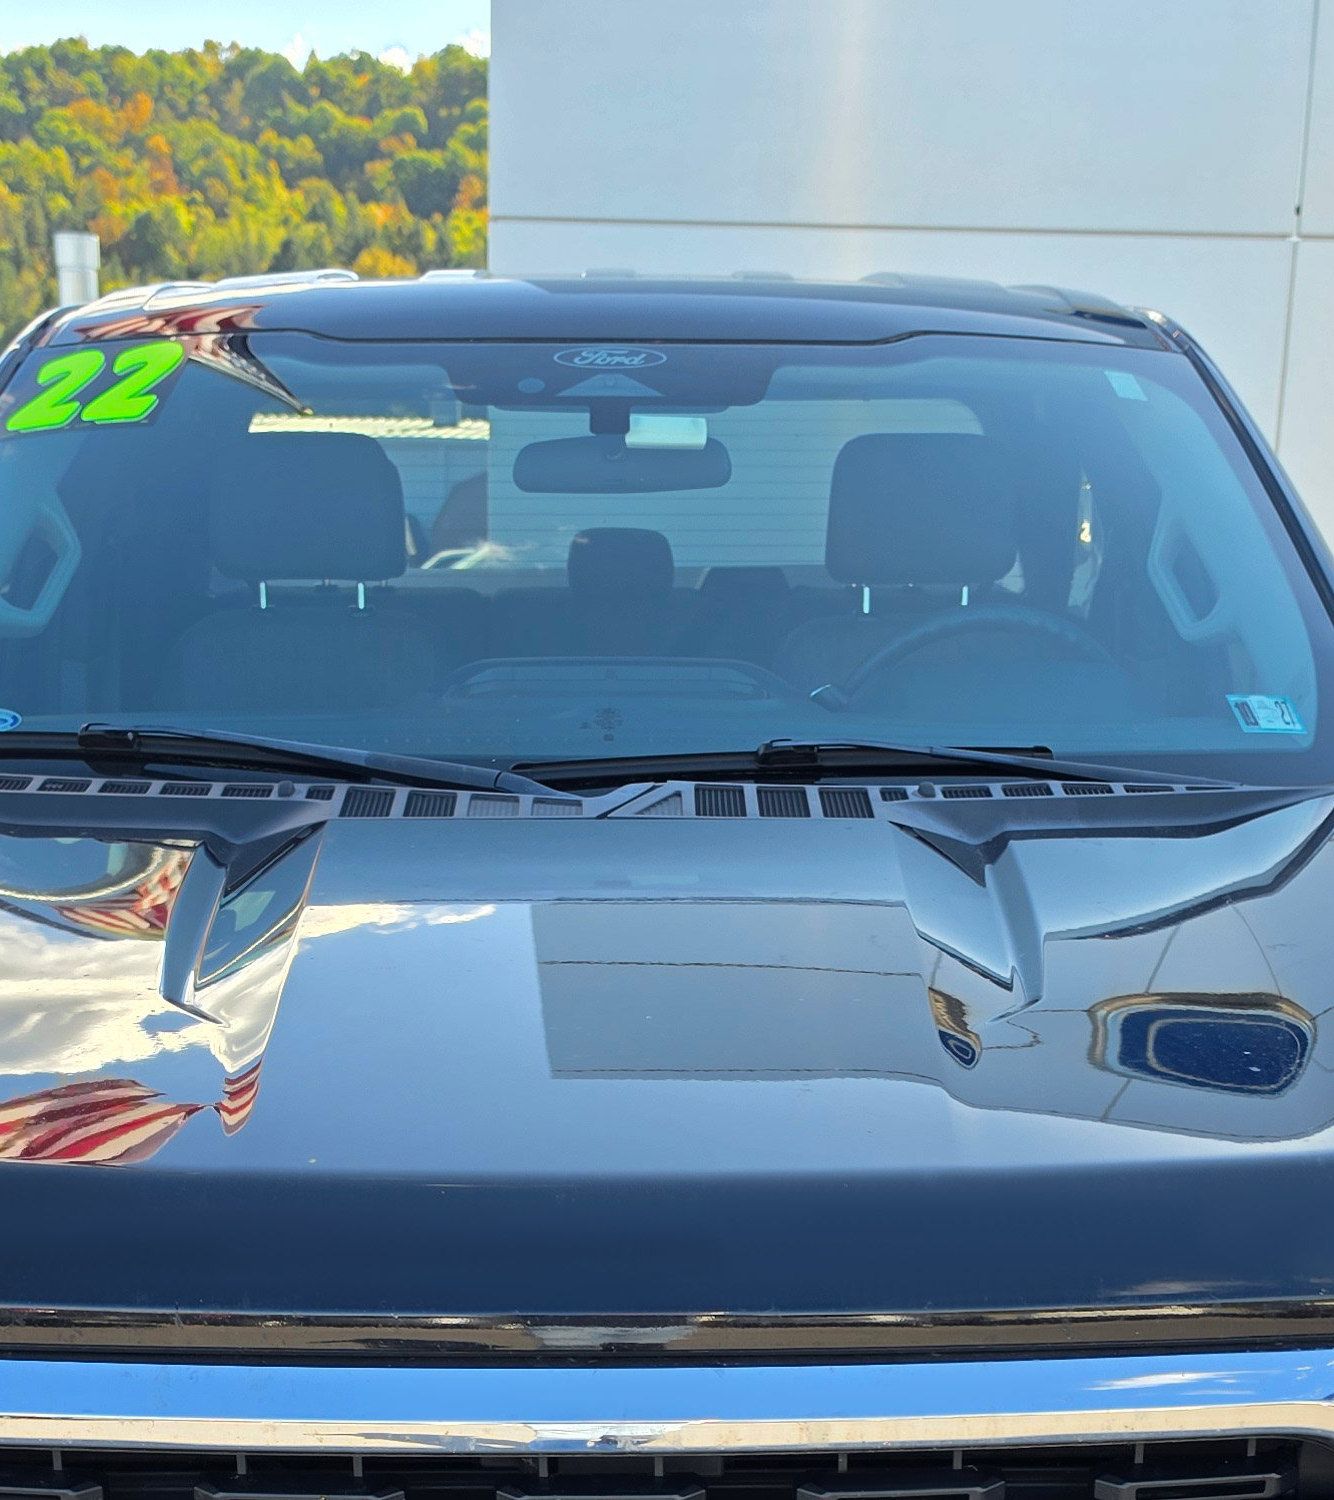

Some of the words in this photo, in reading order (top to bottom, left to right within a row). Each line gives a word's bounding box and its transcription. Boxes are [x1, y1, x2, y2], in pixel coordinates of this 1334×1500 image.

[573, 350, 647, 365] Ford
[5, 341, 185, 433] 22
[1274, 700, 1296, 727] 27
